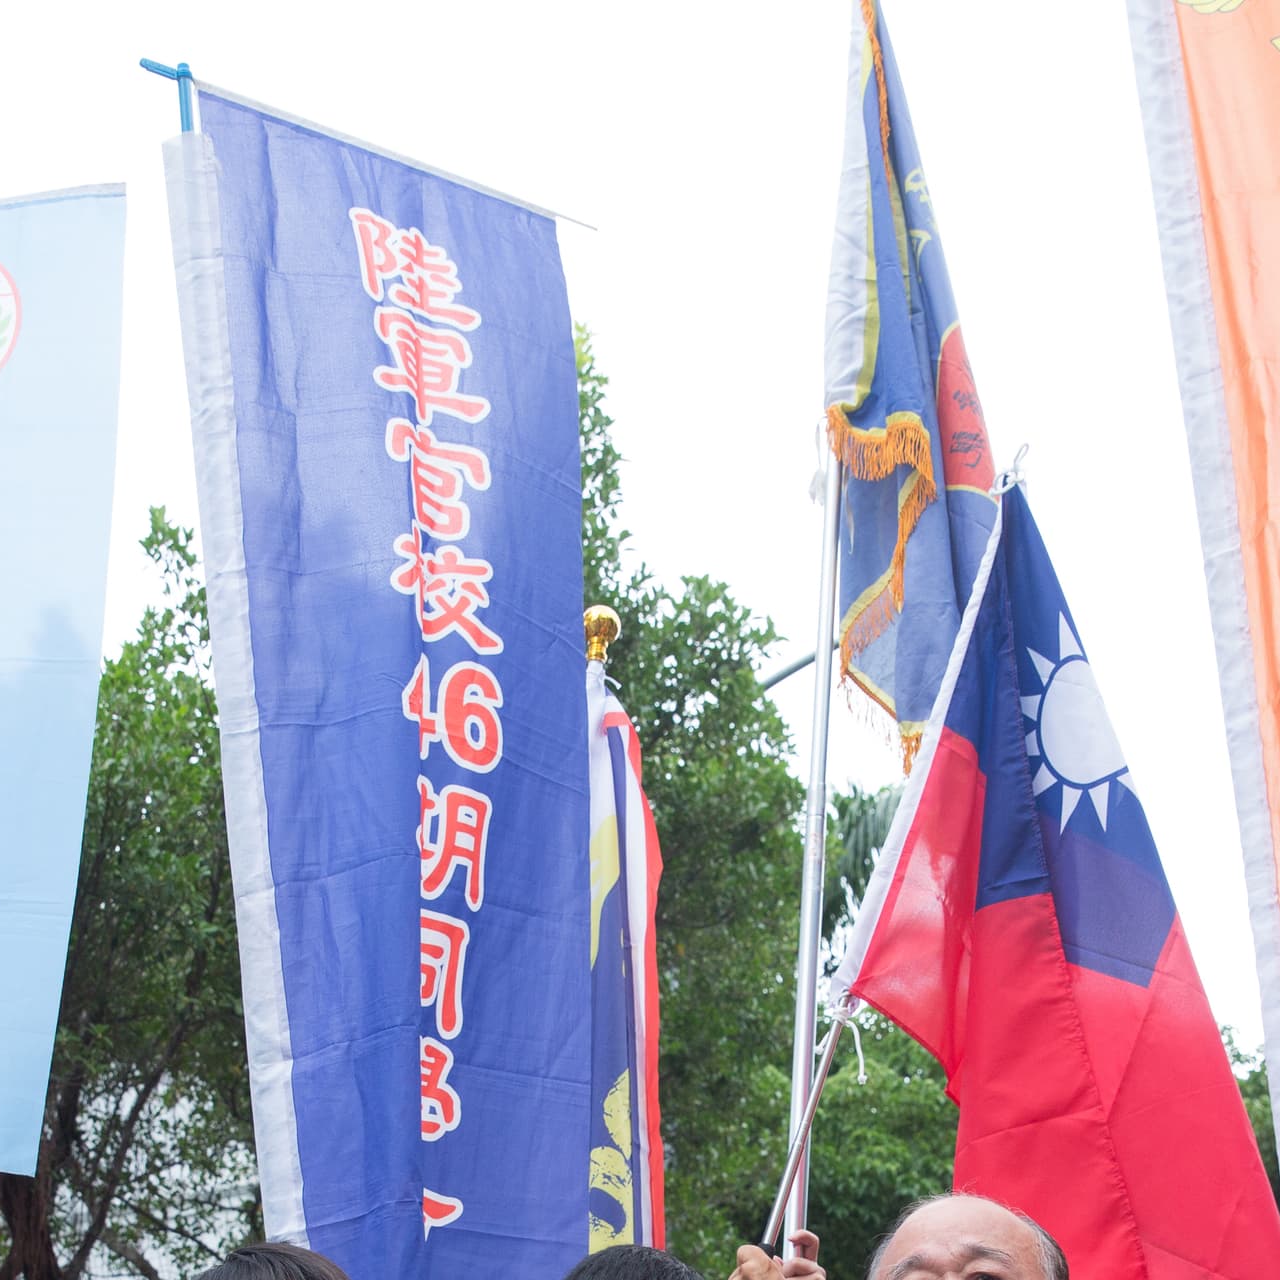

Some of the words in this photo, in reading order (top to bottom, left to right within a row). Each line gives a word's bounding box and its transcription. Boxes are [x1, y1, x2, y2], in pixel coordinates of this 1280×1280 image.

[350, 207, 504, 1240] 陸軍官校46期同
